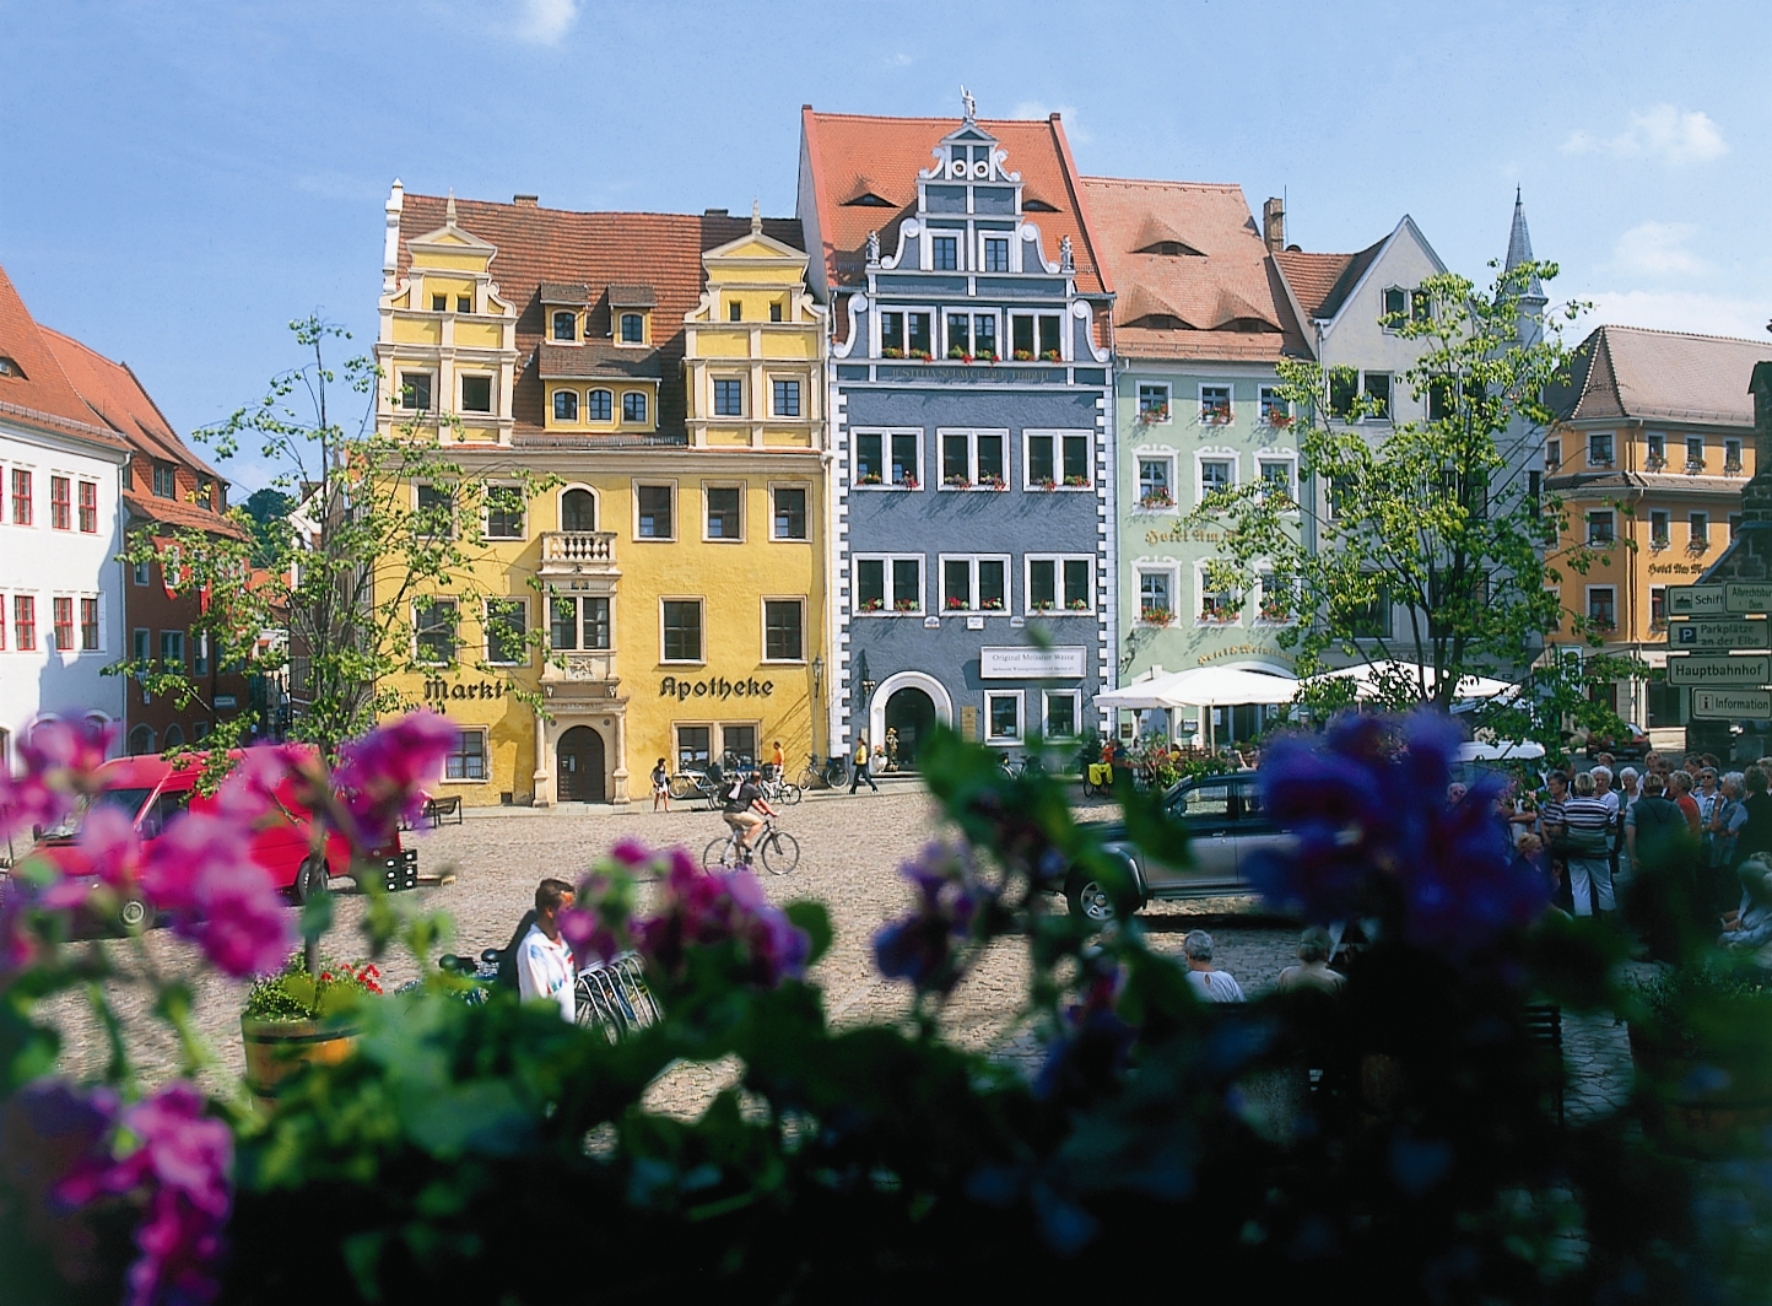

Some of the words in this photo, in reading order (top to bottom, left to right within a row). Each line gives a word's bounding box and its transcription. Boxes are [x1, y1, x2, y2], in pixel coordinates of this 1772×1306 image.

[1701, 624, 1754, 635] Parkplätze
[1718, 636, 1734, 645] der
[1738, 636, 1760, 645] Elbe
[992, 653, 1020, 662] Original
[1676, 664, 1763, 679] Hauptbahnhof
[424, 679, 503, 700] Markt
[659, 676, 774, 702] Apotheke
[1715, 697, 1769, 710] Information
